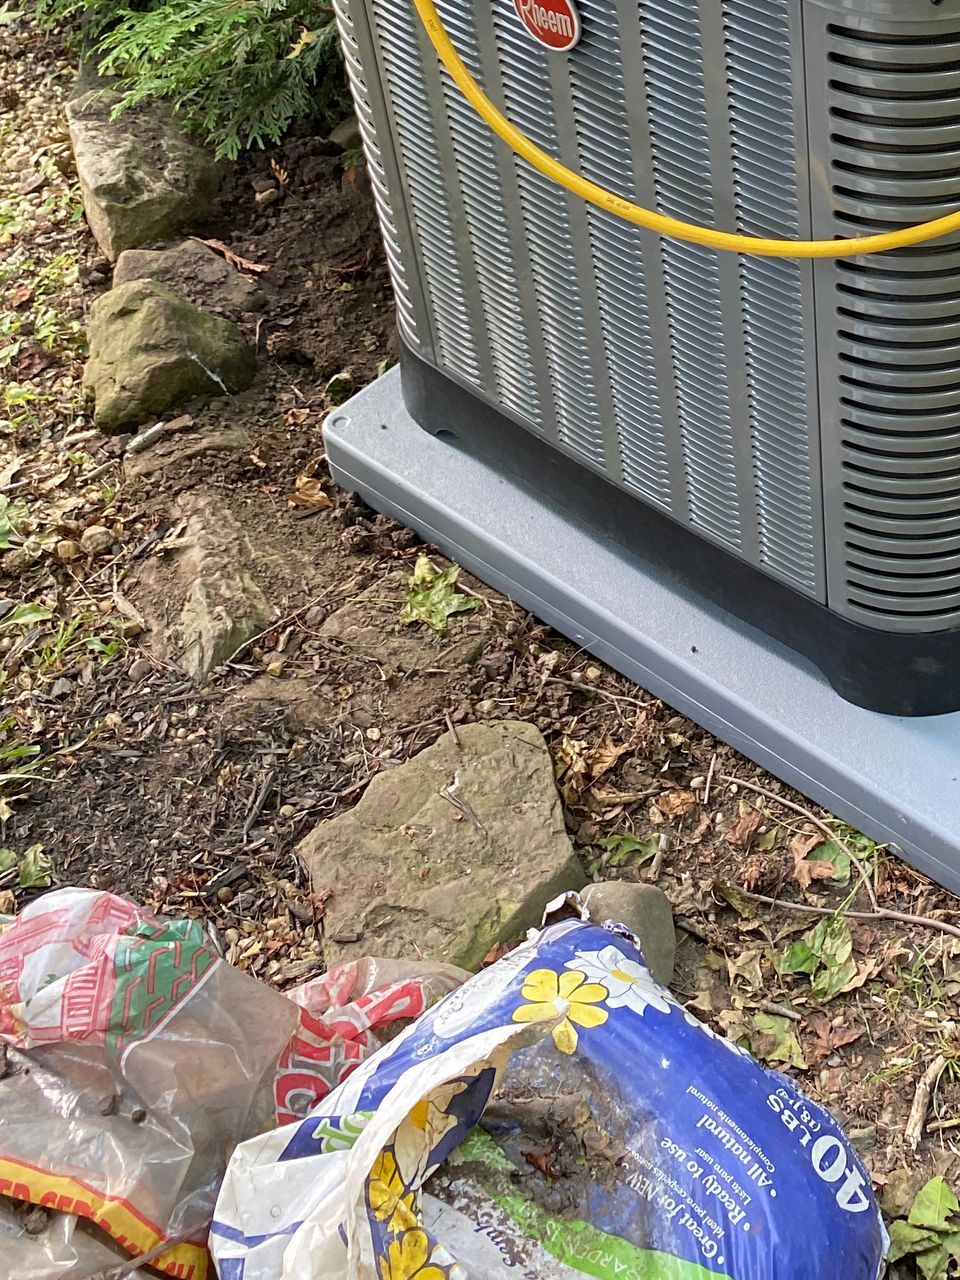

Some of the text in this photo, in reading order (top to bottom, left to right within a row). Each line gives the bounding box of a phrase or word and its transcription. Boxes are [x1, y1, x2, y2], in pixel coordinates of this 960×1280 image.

[686, 1085, 775, 1173] Completamente natural
[695, 1114, 773, 1188] All natural
[766, 1094, 812, 1147] LBS
[660, 1137, 746, 1225] Ready to use
[686, 1197, 707, 1218] para
[694, 1146, 752, 1206] Lista para usar
[811, 1134, 869, 1212] 40
[626, 1170, 718, 1259] Great for NEW
[702, 1216, 725, 1239] Ideal
